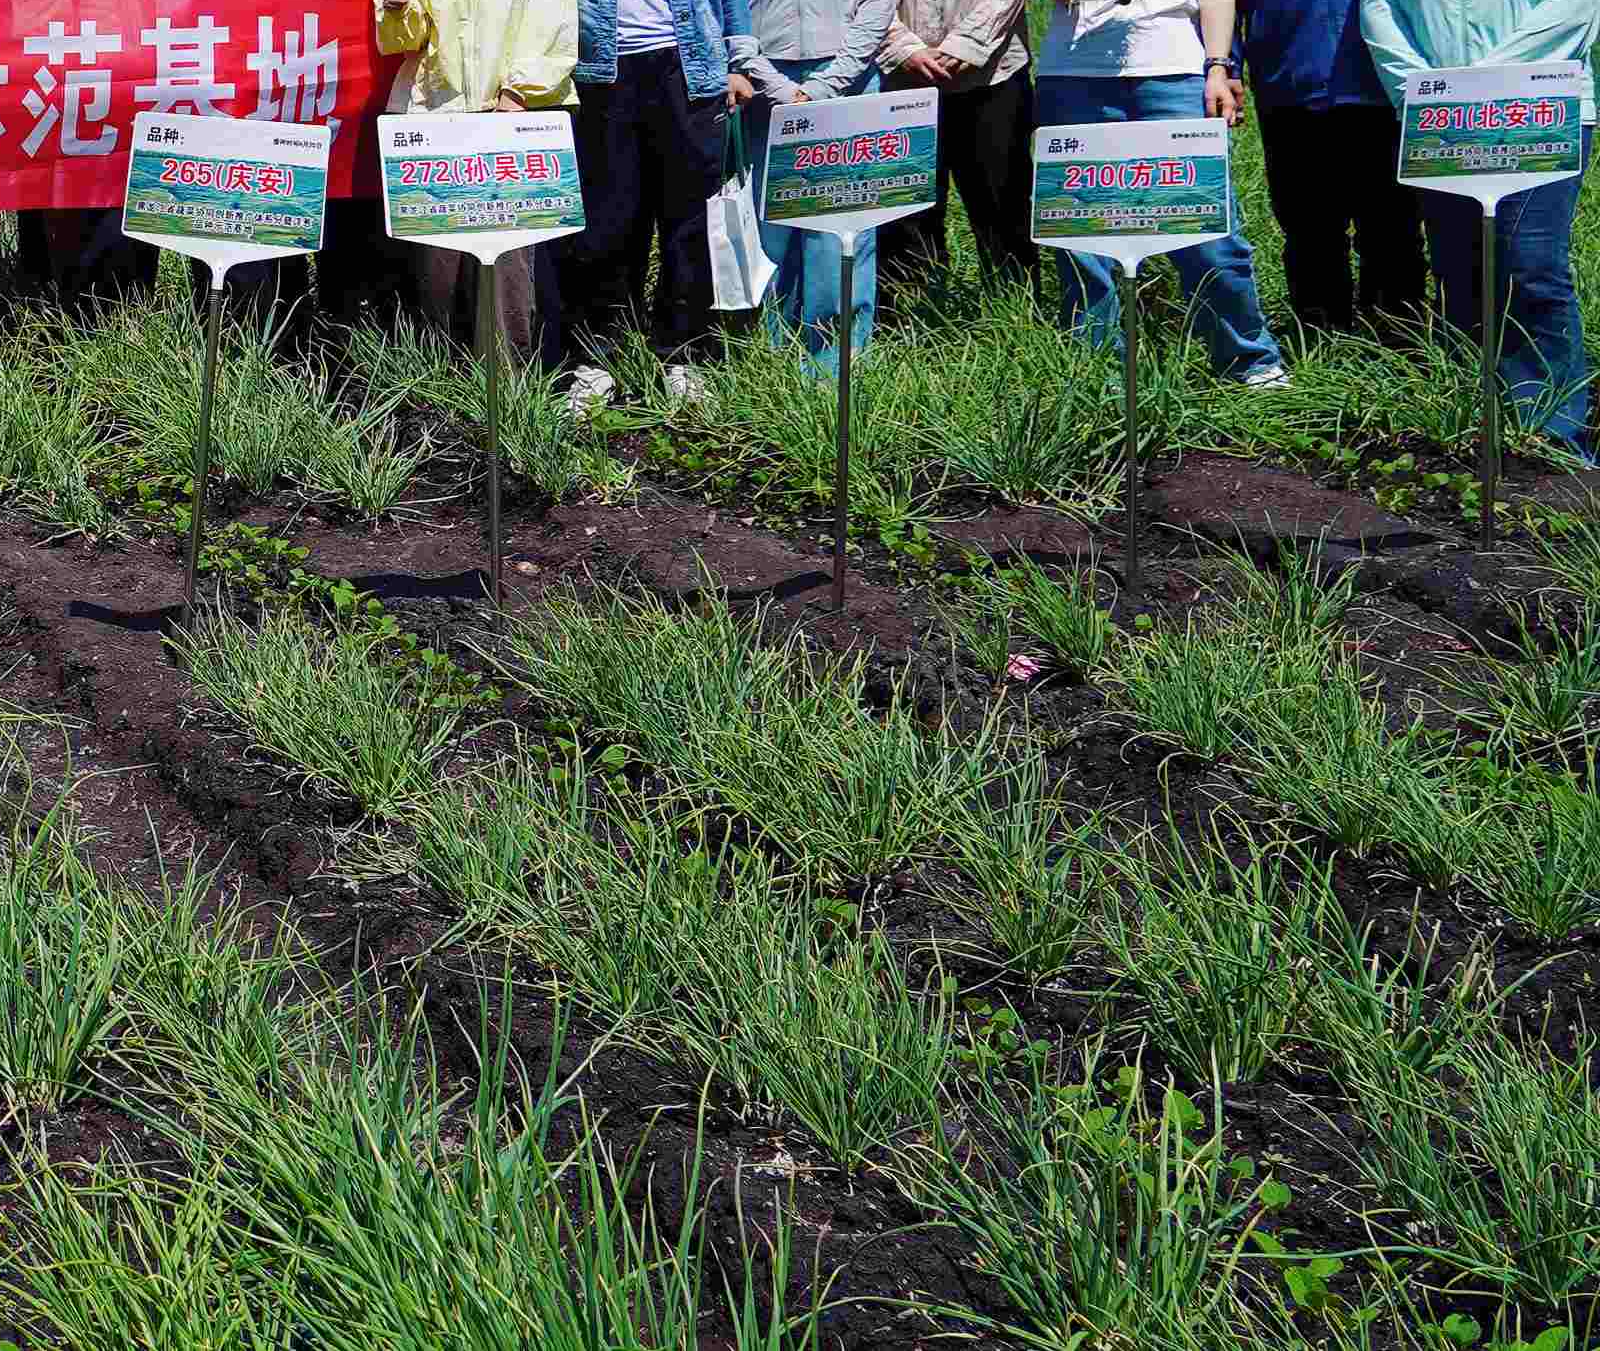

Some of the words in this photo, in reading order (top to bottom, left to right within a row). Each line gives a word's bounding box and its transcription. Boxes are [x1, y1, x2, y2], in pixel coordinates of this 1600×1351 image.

[1419, 99, 1566, 131] 281(北安市)
[794, 132, 911, 170] 266(庆安)
[160, 158, 294, 196] 265(庆安)
[400, 154, 561, 185] 272(孙吴县)
[1064, 161, 1197, 190] 210(方正)
